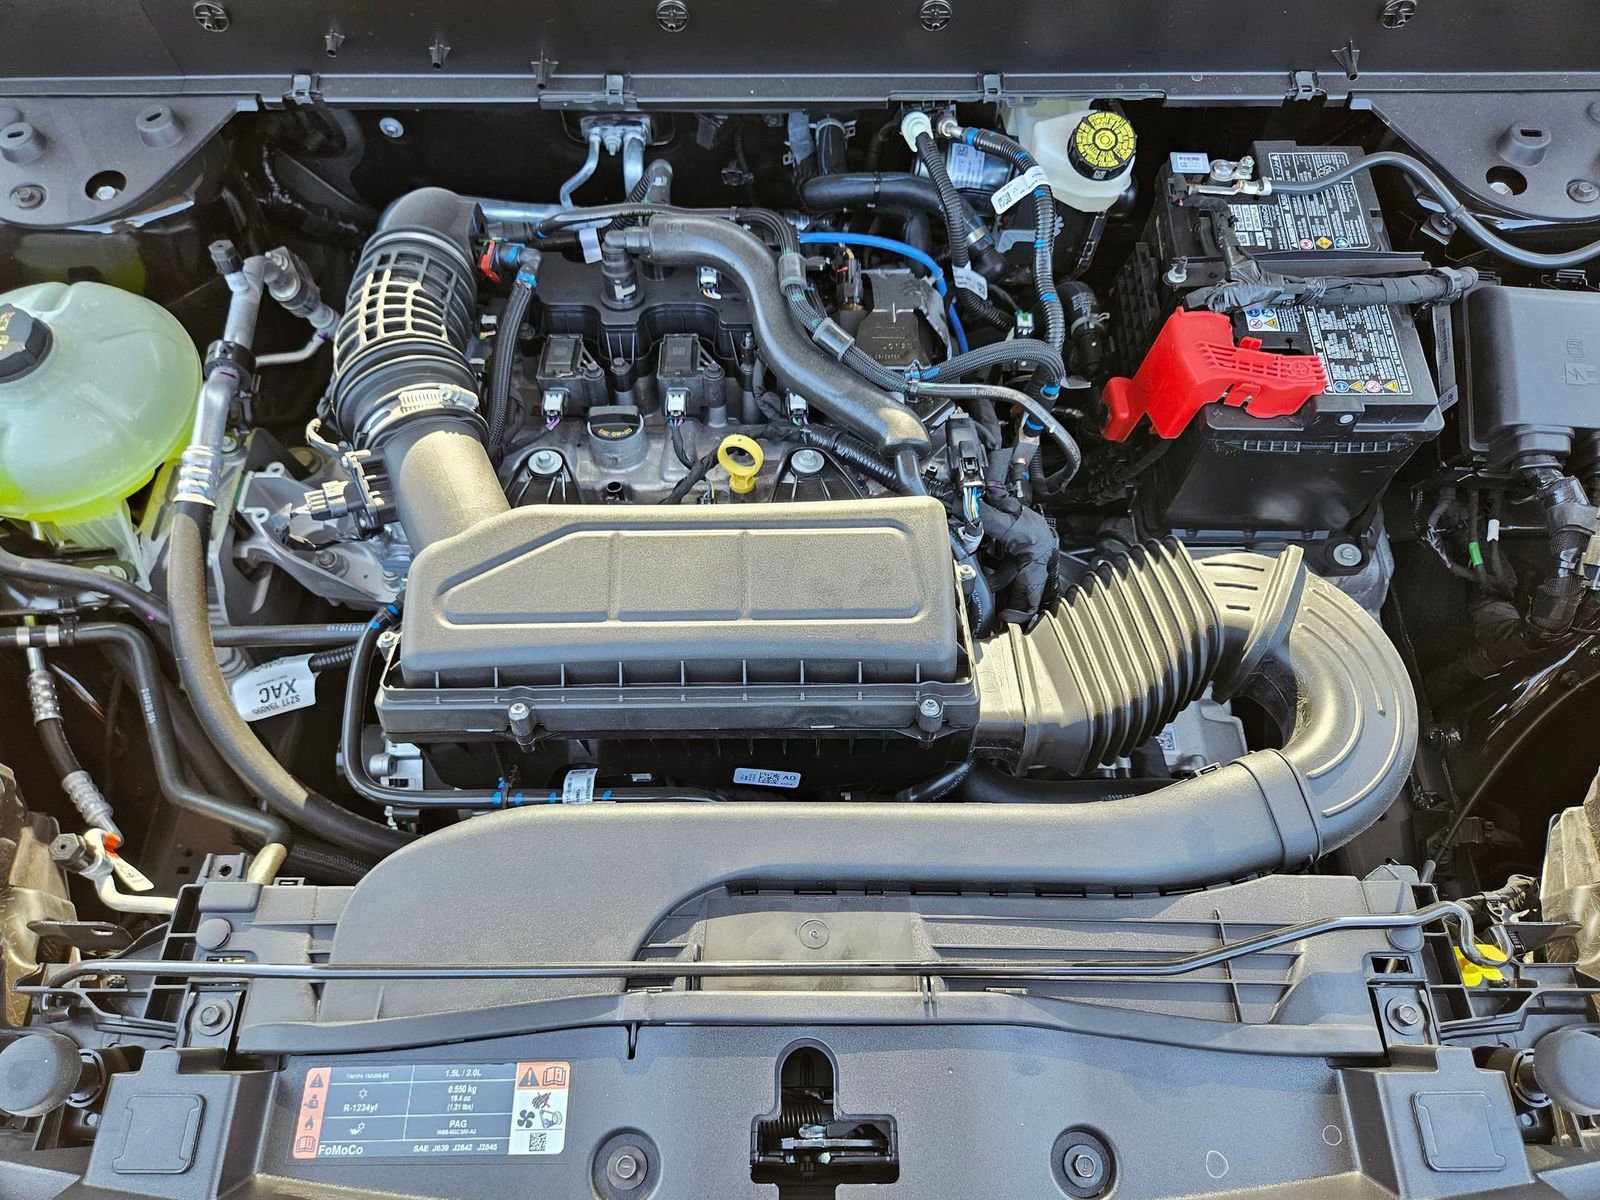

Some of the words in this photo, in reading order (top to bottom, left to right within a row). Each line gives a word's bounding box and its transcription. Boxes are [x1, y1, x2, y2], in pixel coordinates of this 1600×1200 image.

[259, 678, 297, 704] XAC
[445, 1069, 460, 1077] 1.5L
[465, 1069, 482, 1077] 2.0L
[448, 1085, 467, 1094] 0.550
[467, 1084, 477, 1095] kg
[343, 1103, 379, 1114] R-1234yf
[449, 1119, 468, 1128] PAG
[317, 1144, 364, 1155] FoMoCo
[413, 1144, 429, 1152] SAE
[432, 1144, 450, 1152] J639
